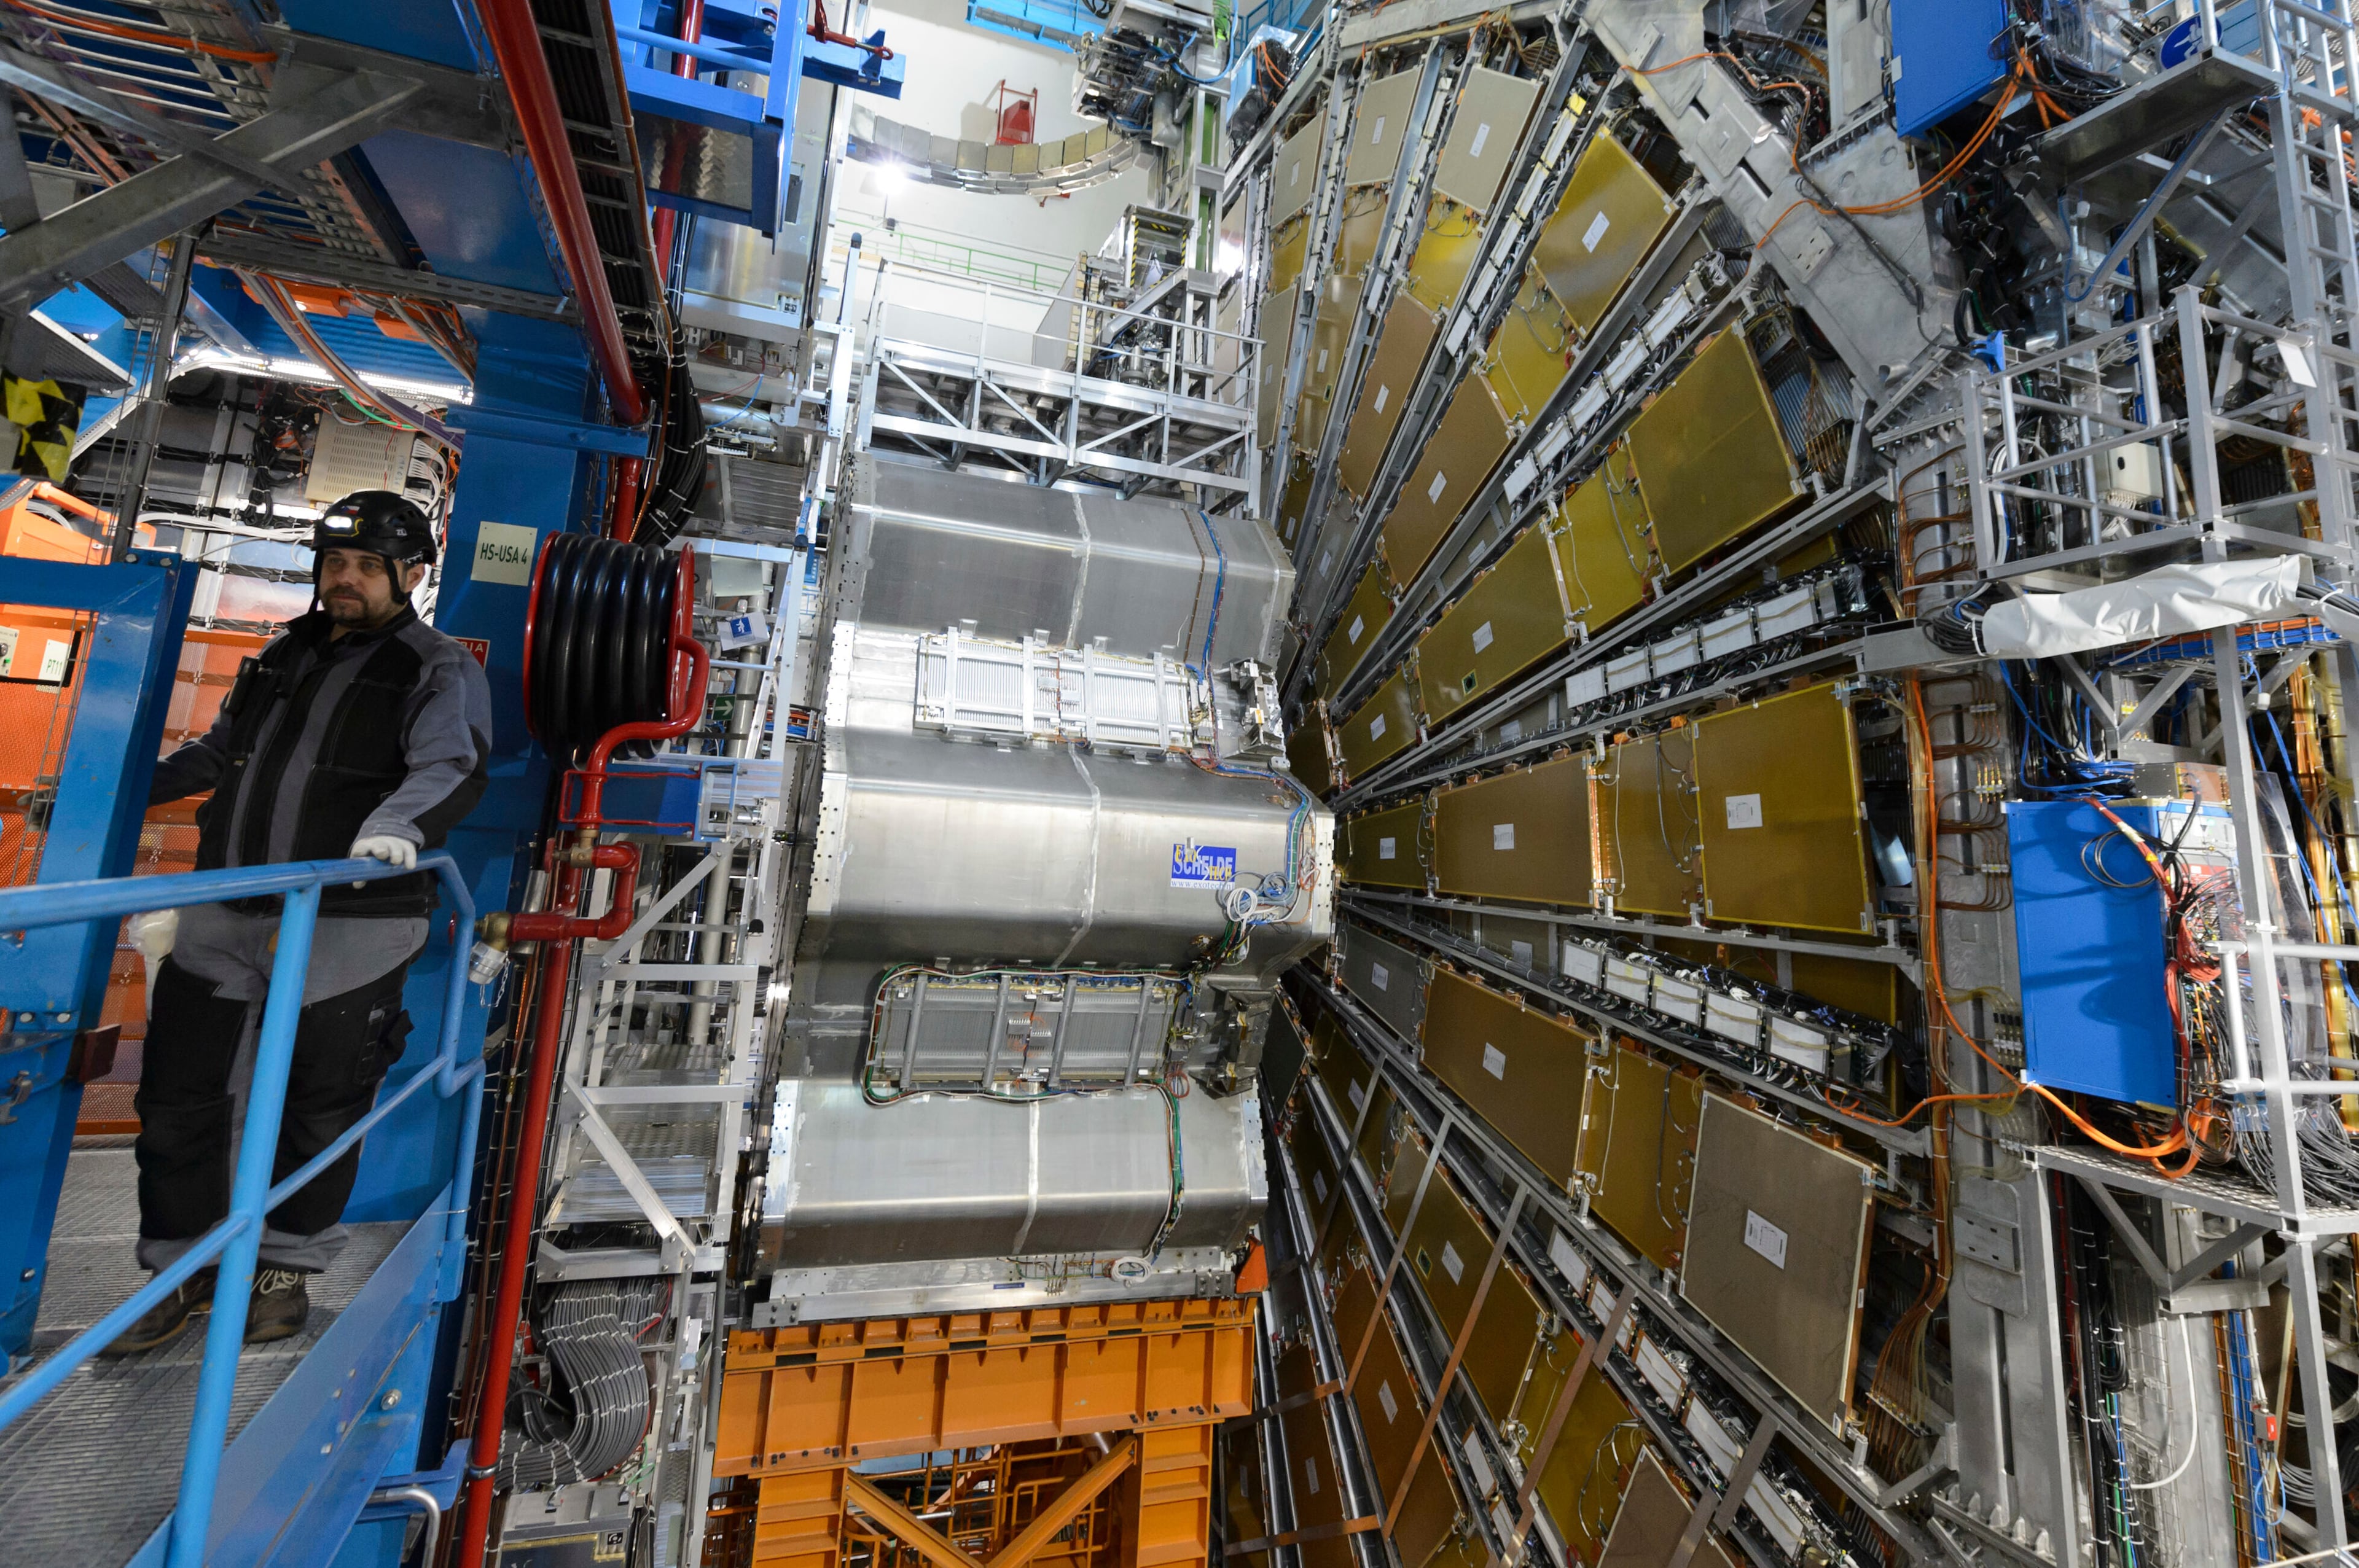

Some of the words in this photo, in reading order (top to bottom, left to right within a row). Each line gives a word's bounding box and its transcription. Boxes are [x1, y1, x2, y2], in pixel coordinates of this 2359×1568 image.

[480, 542, 518, 564] HS-USA
[521, 547, 528, 564] 4
[1171, 880, 1234, 890] www.exotechnl
